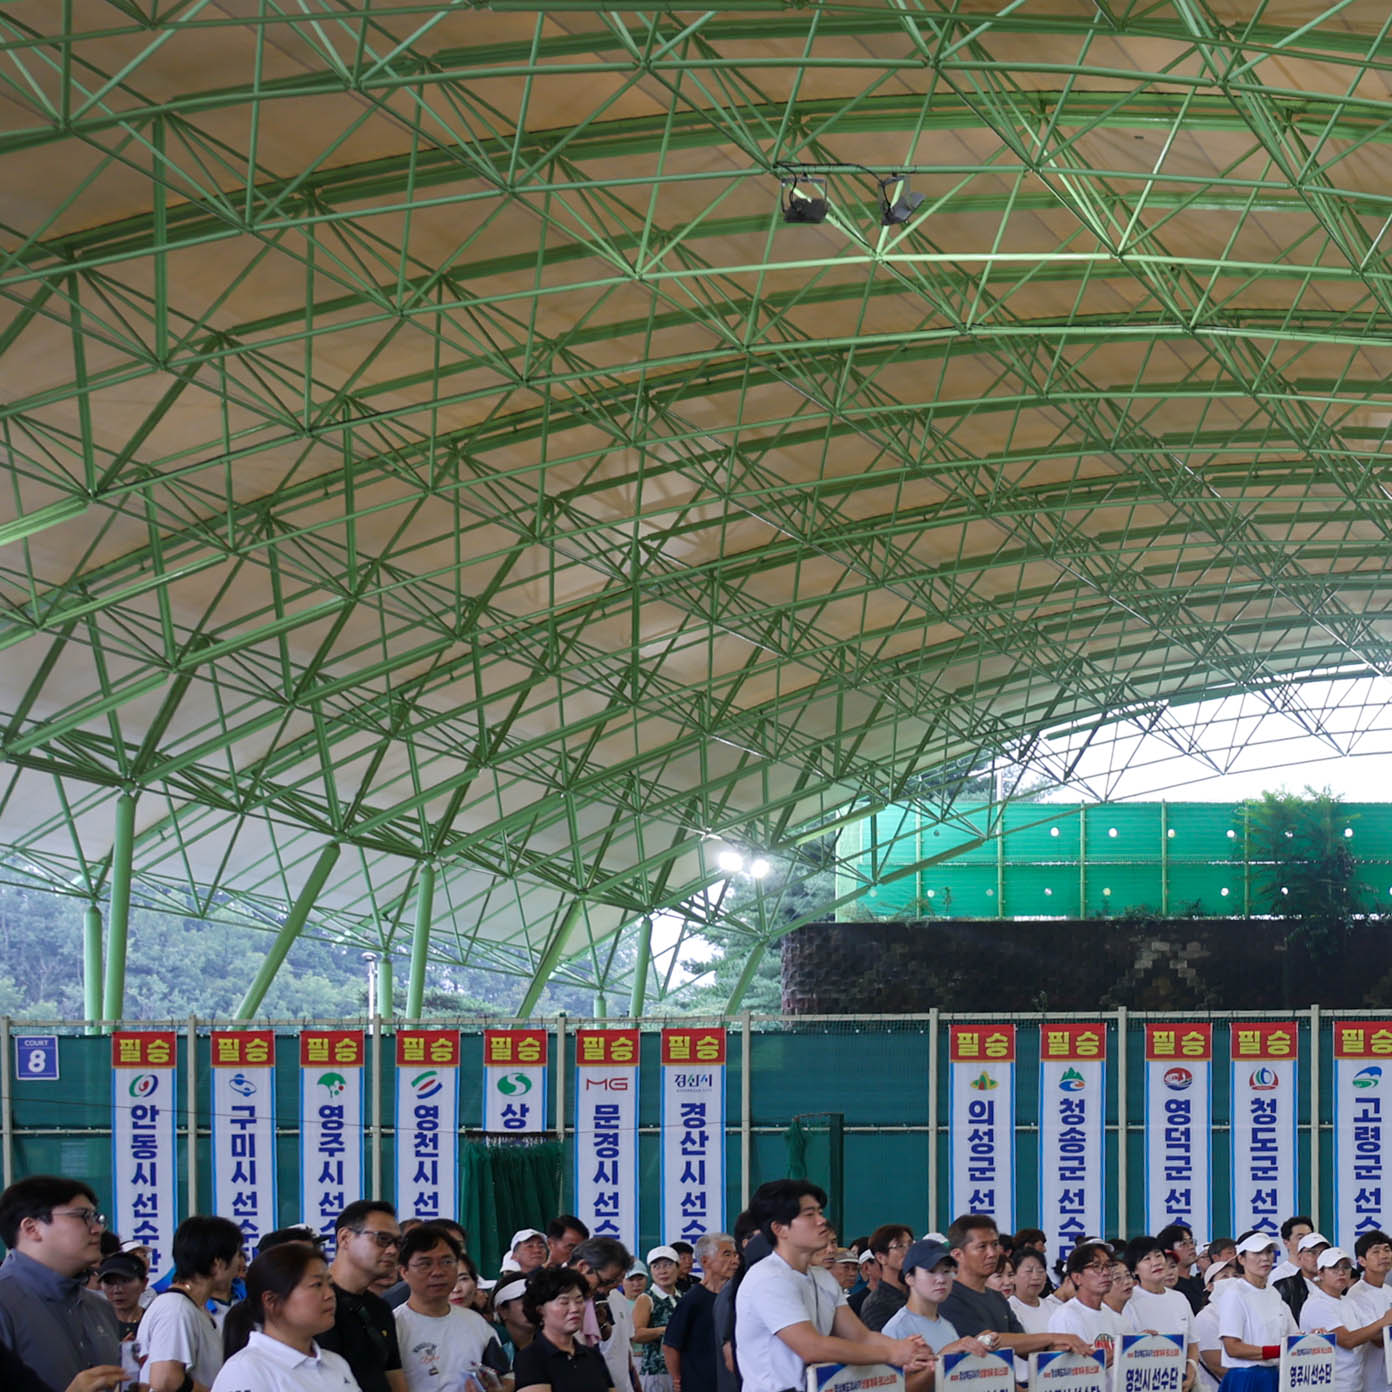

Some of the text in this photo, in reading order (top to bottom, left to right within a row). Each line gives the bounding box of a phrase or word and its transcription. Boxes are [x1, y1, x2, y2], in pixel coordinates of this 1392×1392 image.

[24, 1039, 49, 1047] COURT
[119, 1039, 170, 1063] 필승
[218, 1038, 269, 1062] 필승
[307, 1038, 358, 1062] 필승
[403, 1038, 453, 1062] 필승
[491, 1037, 541, 1061] 필승
[583, 1036, 633, 1061] 필승
[668, 1036, 719, 1060] 필승
[957, 1032, 1009, 1057] 필승
[1048, 1031, 1099, 1056] 필승
[1152, 1031, 1205, 1056] 필승
[1238, 1031, 1291, 1055] 필승
[28, 1049, 46, 1073] 8
[586, 1077, 629, 1092] MG
[130, 1104, 160, 1187] 안동시
[230, 1105, 258, 1185] 구미시
[318, 1104, 345, 1185] 영주시
[413, 1104, 440, 1185] 영천시
[593, 1104, 620, 1186] 문경시
[680, 1102, 709, 1186] 경산시
[968, 1100, 996, 1182] 의성군
[1058, 1098, 1086, 1182] 청송군
[1164, 1099, 1192, 1181] 영덕군
[1250, 1098, 1278, 1181] 청도군
[1353, 1097, 1382, 1180] 고령군
[1126, 1368, 1151, 1392] 영천시
[1152, 1367, 1178, 1391] 선수단
[1290, 1363, 1332, 1388] 영주시 선수단
